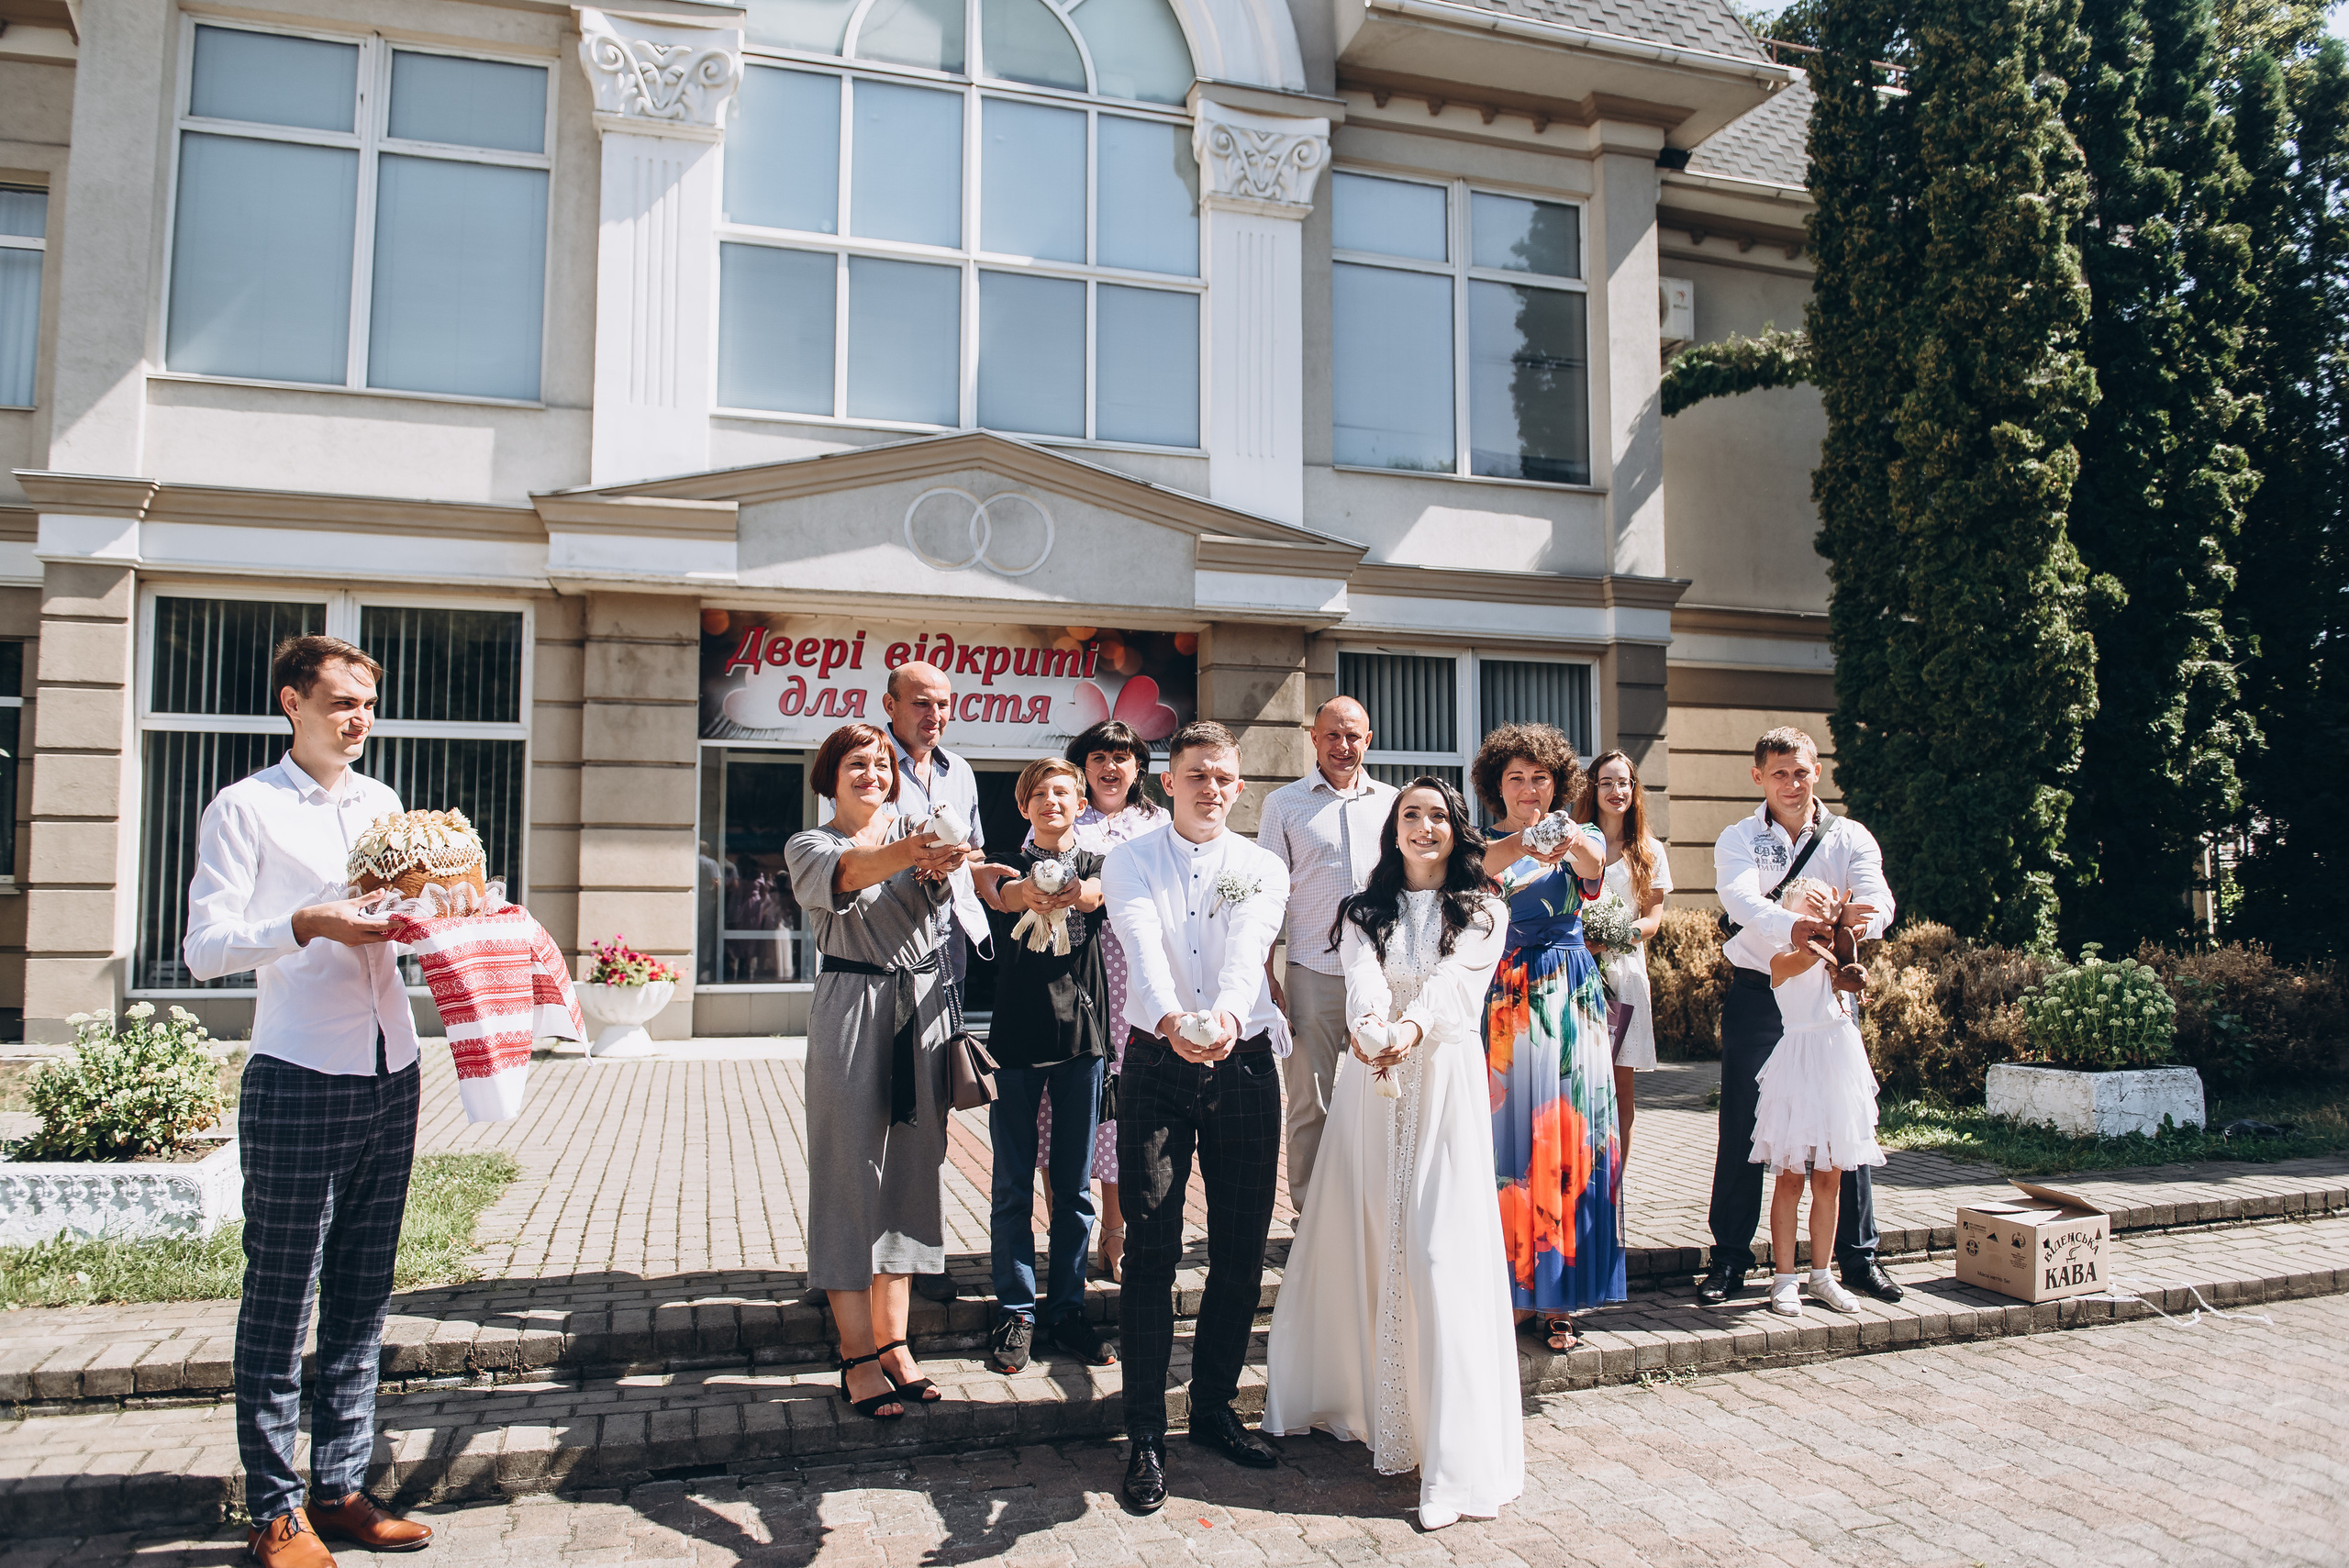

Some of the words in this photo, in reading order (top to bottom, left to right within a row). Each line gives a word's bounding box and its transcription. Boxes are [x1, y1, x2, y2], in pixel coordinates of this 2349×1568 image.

[725, 626, 866, 679] Двері
[885, 632, 1098, 685] відкриті
[778, 674, 867, 717] для
[2044, 1232, 2099, 1263] ВІДЕНСЬКА
[2044, 1262, 2098, 1290] КАВА
